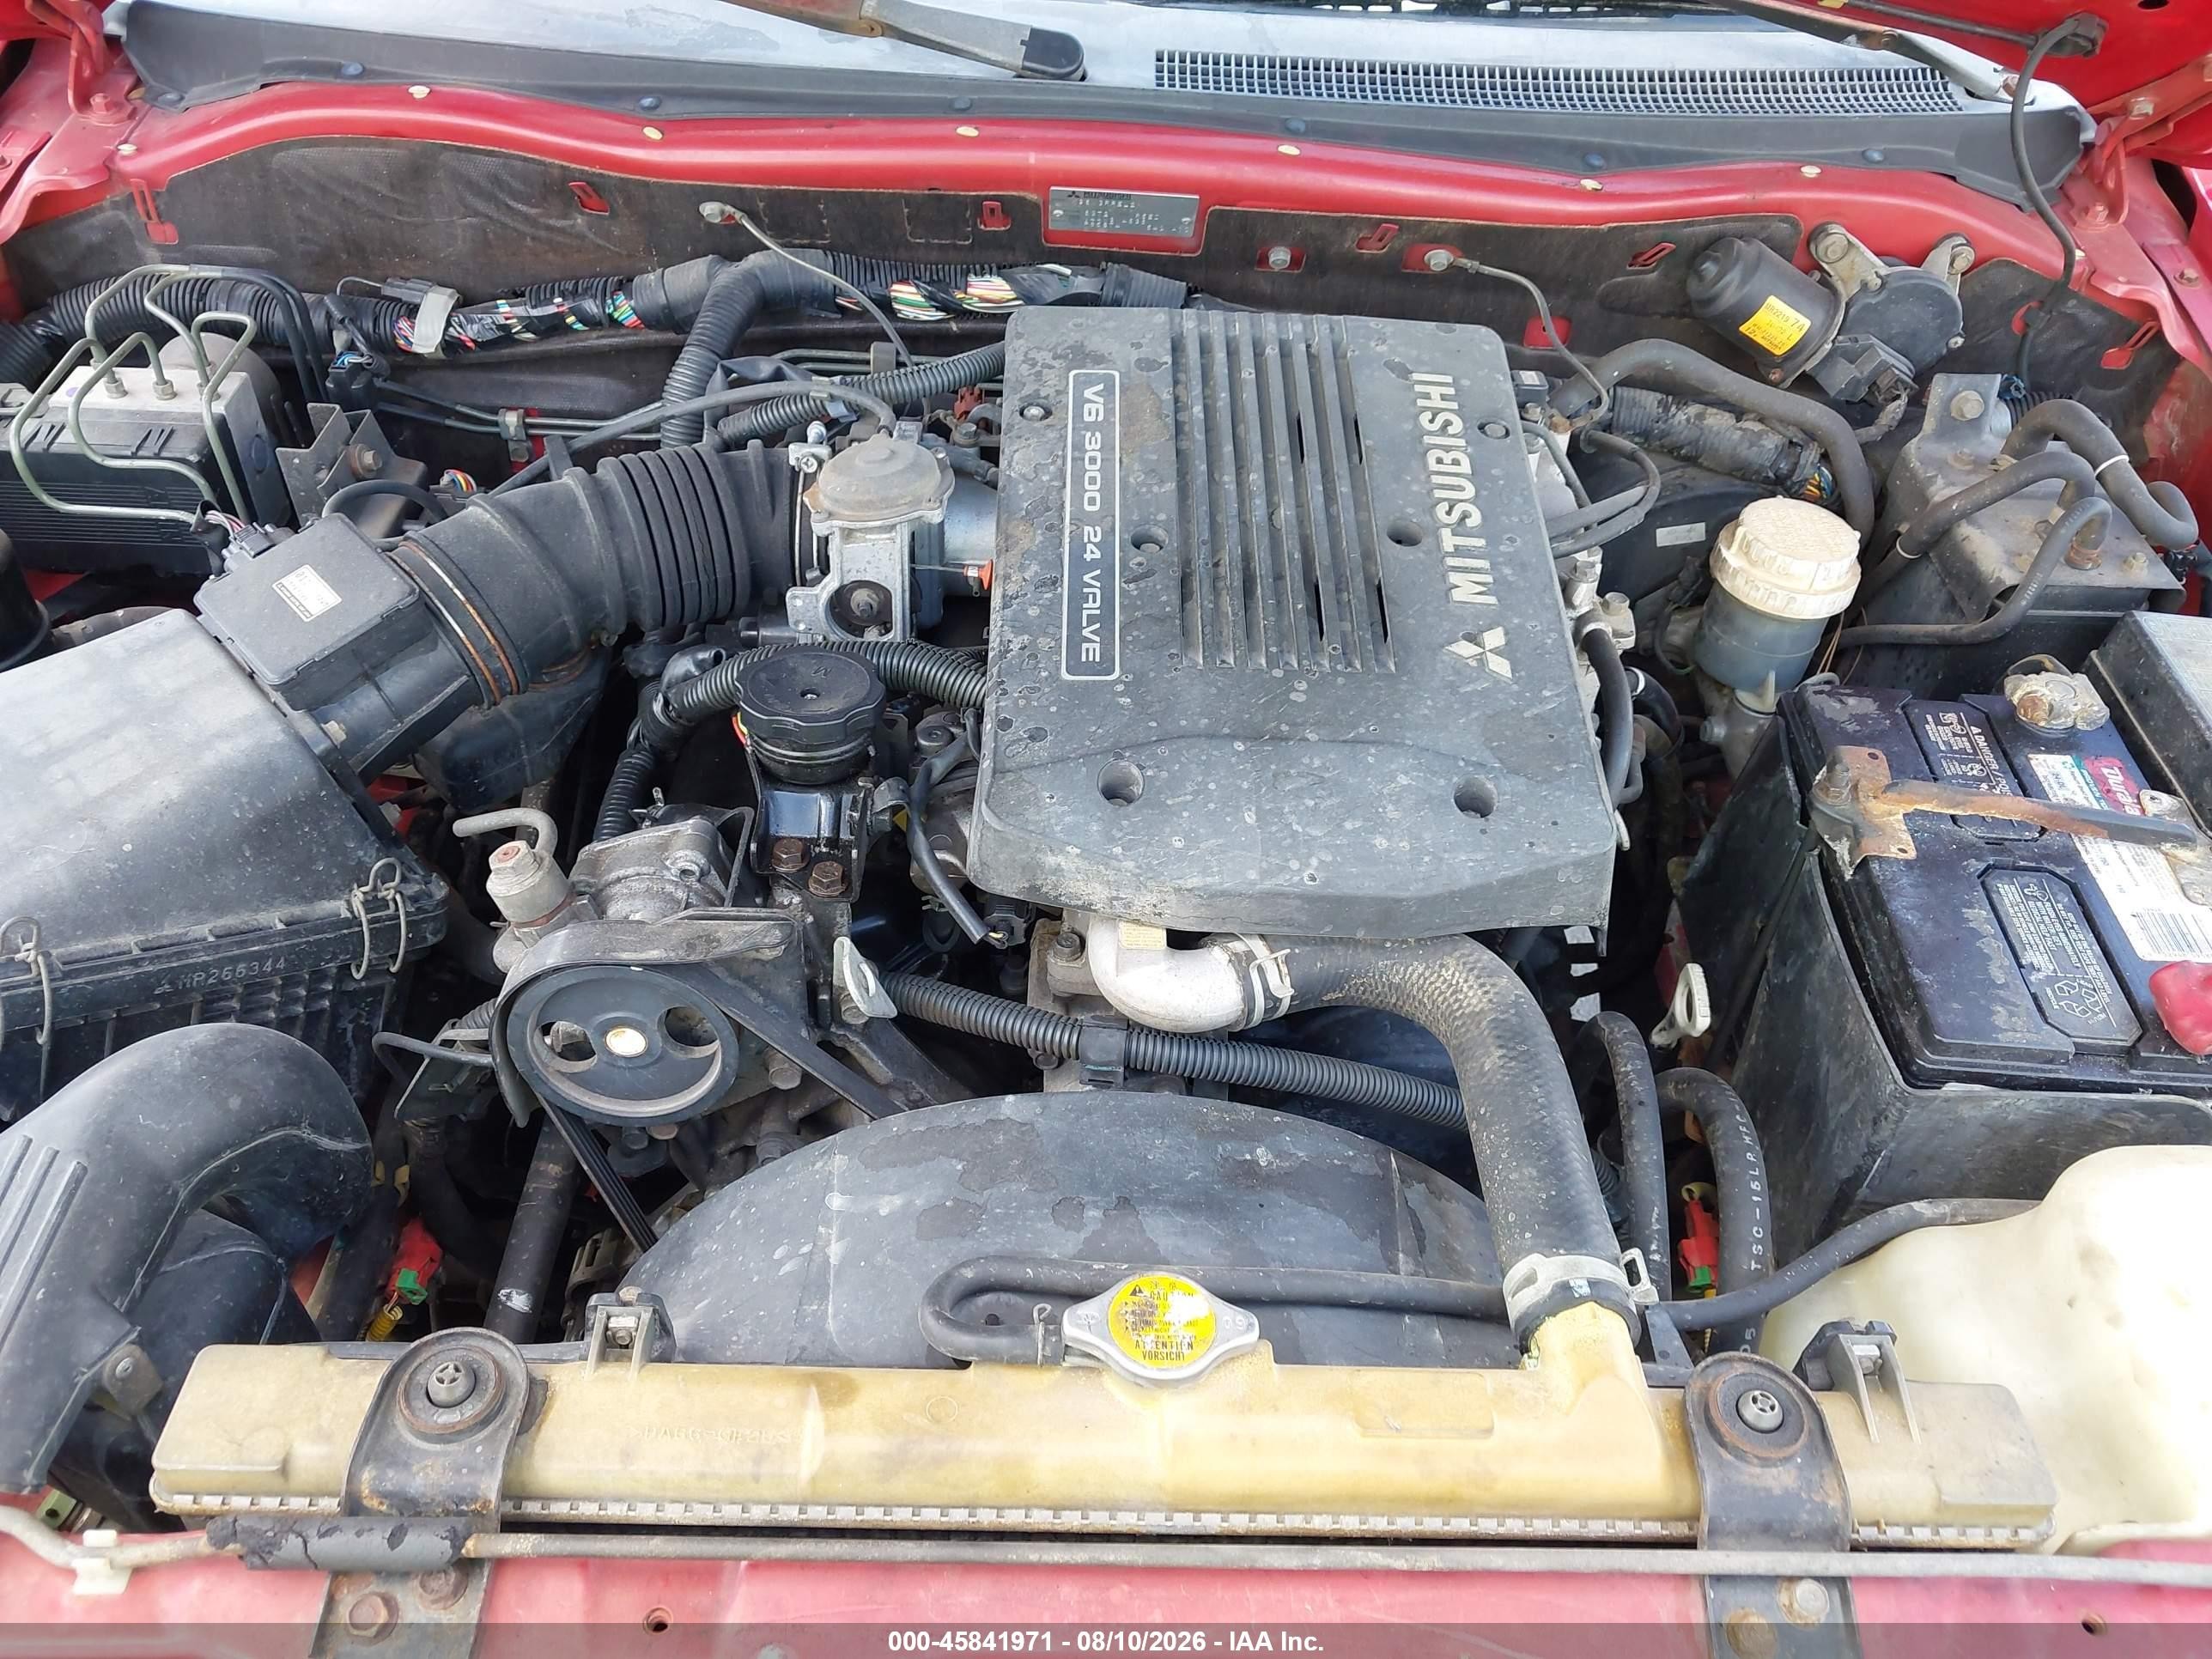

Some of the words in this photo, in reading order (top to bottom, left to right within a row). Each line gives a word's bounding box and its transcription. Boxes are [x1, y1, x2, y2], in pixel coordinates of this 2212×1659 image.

[1083, 383, 1104, 422] V6
[1083, 431, 1102, 511] 3000
[1410, 373, 1499, 605] MITSUBISHI
[1083, 526, 1102, 562] 24
[1081, 569, 1102, 662] VALVE
